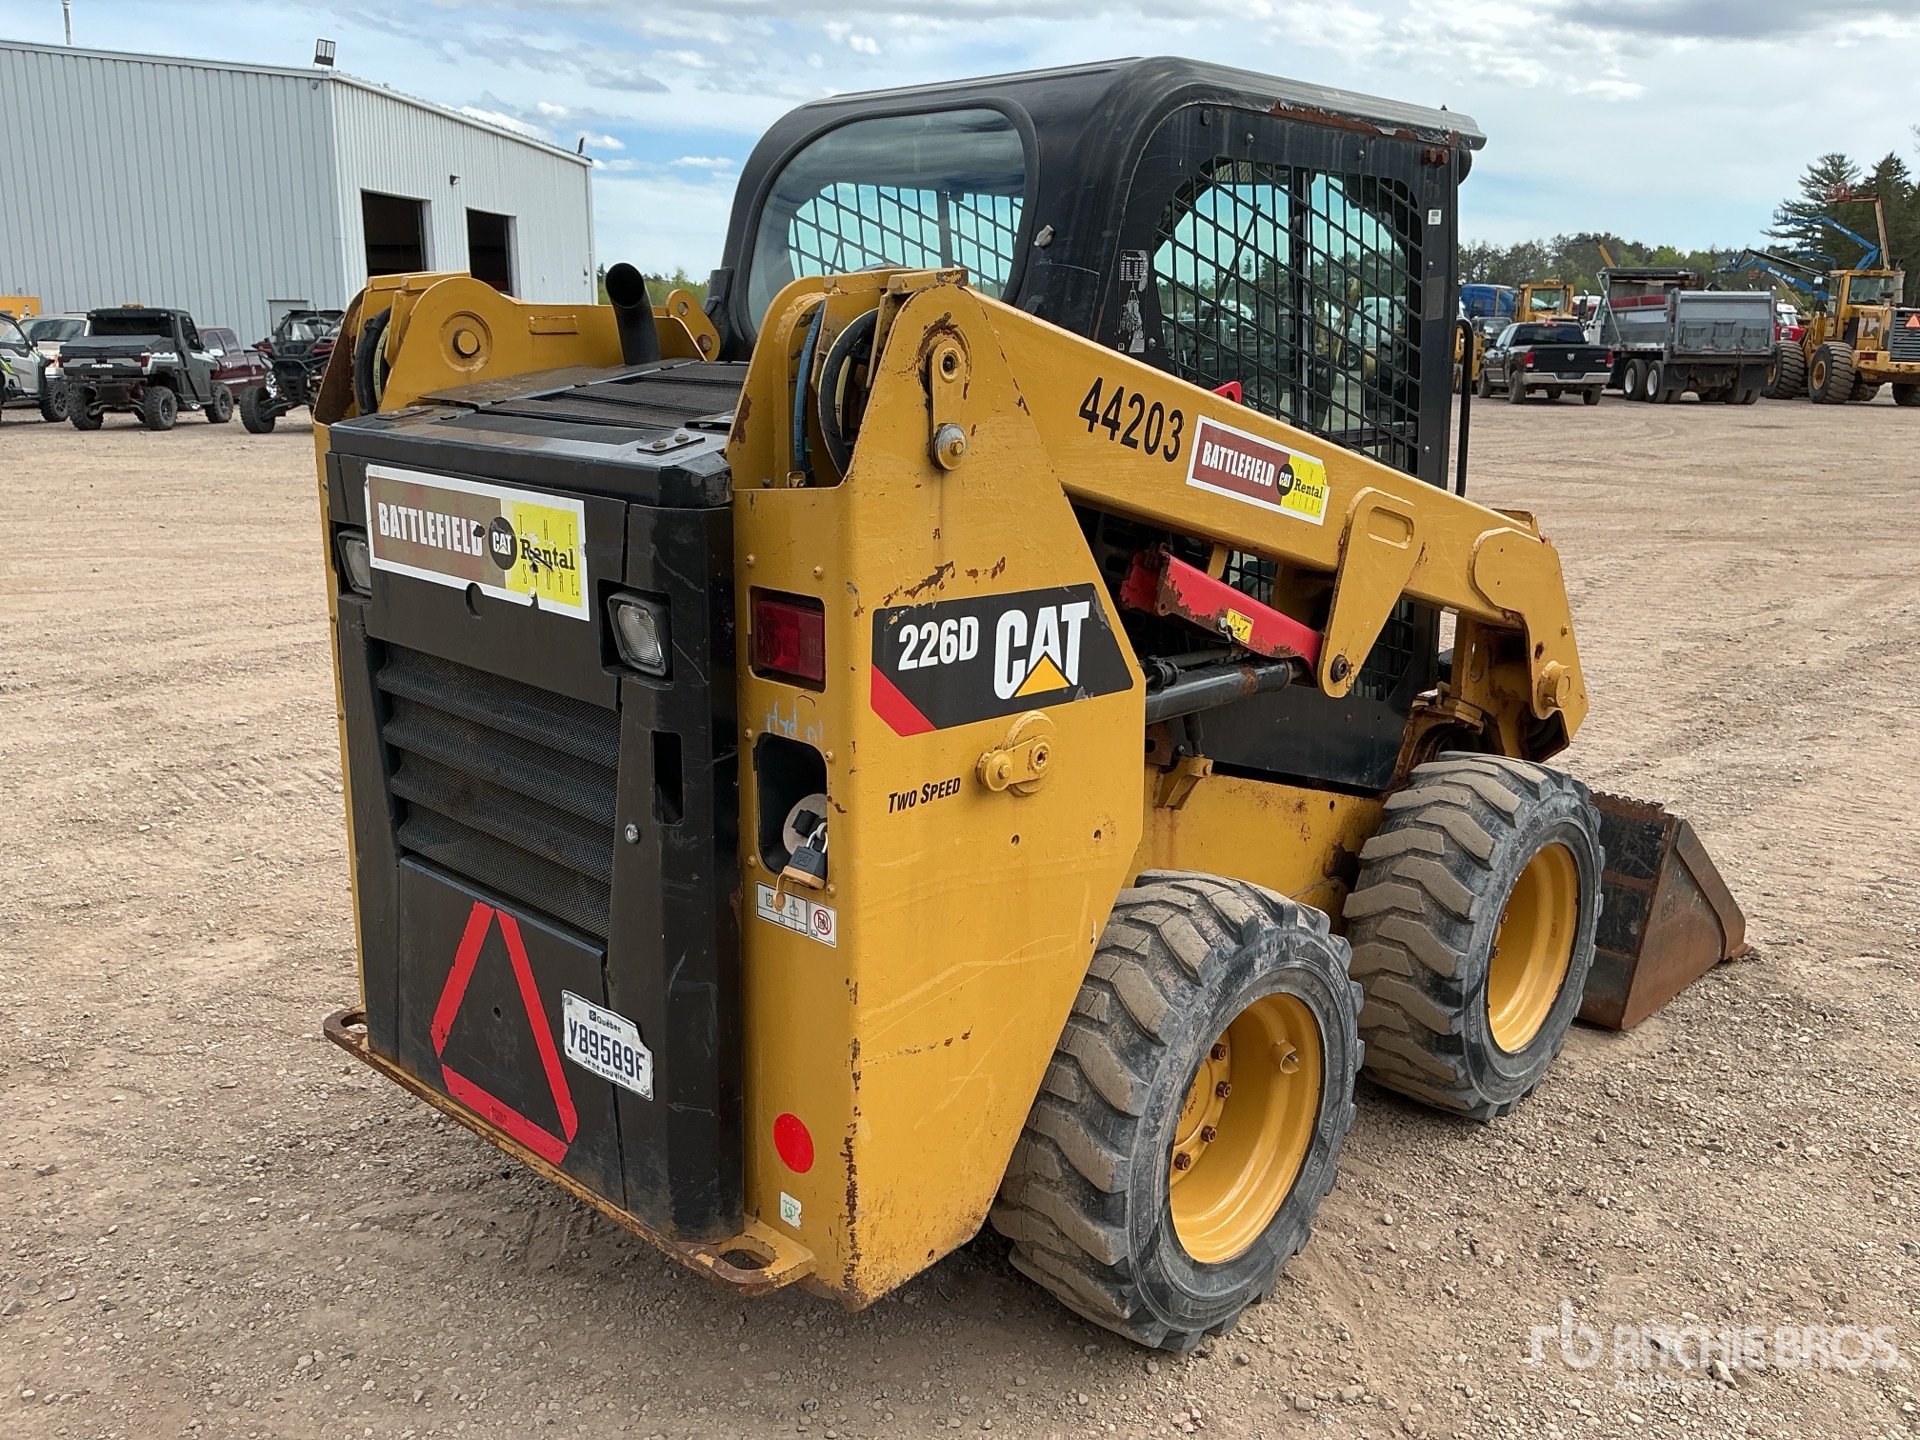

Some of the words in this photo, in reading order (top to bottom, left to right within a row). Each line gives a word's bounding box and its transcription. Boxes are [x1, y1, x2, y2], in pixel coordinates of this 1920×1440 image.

[1078, 377, 1185, 463] 44203
[1202, 441, 1275, 487] BATTLEFIELD
[1278, 471, 1292, 488] CAT
[1294, 477, 1324, 499] Rental
[378, 502, 484, 557] BATTLEFIELD
[492, 531, 512, 556] CAT
[519, 538, 576, 571] Rental
[898, 616, 979, 670] 226D
[993, 601, 1090, 700] CAT
[888, 790, 918, 813] TWO
[920, 777, 961, 804] SPEED
[596, 1015, 622, 1034] Québec
